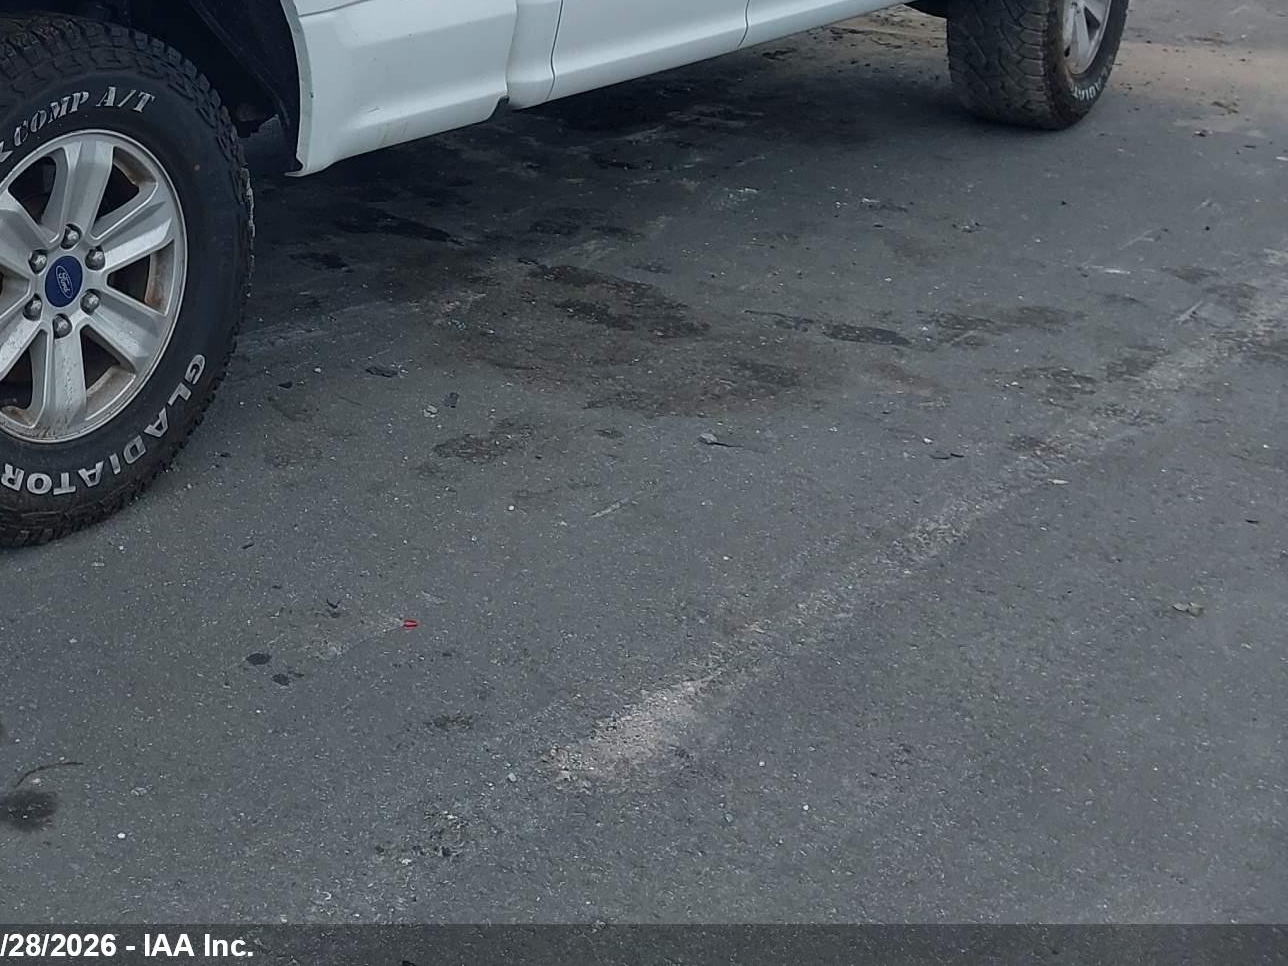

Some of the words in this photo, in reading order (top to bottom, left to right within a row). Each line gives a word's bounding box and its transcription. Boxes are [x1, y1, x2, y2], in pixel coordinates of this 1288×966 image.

[13, 91, 90, 147] COMP
[95, 85, 157, 114] A/T
[0, 353, 207, 496] GLADIATOR
